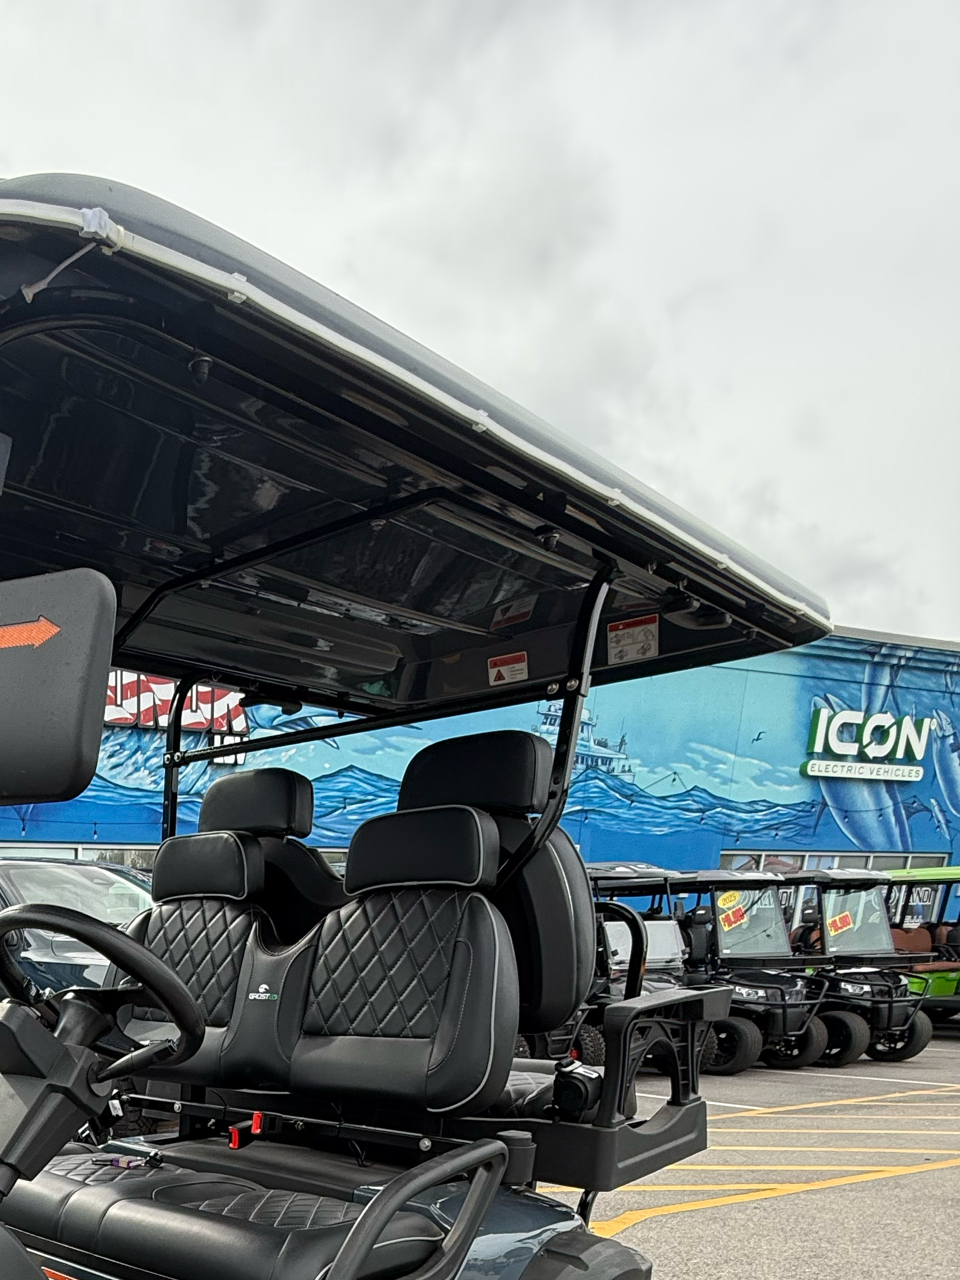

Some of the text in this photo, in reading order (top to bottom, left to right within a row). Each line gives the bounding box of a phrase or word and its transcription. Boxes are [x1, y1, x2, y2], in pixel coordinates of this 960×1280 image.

[813, 708, 932, 761] ICON
[810, 763, 921, 778] ELECTRIC VEHICLES
[721, 892, 737, 906] 2025
